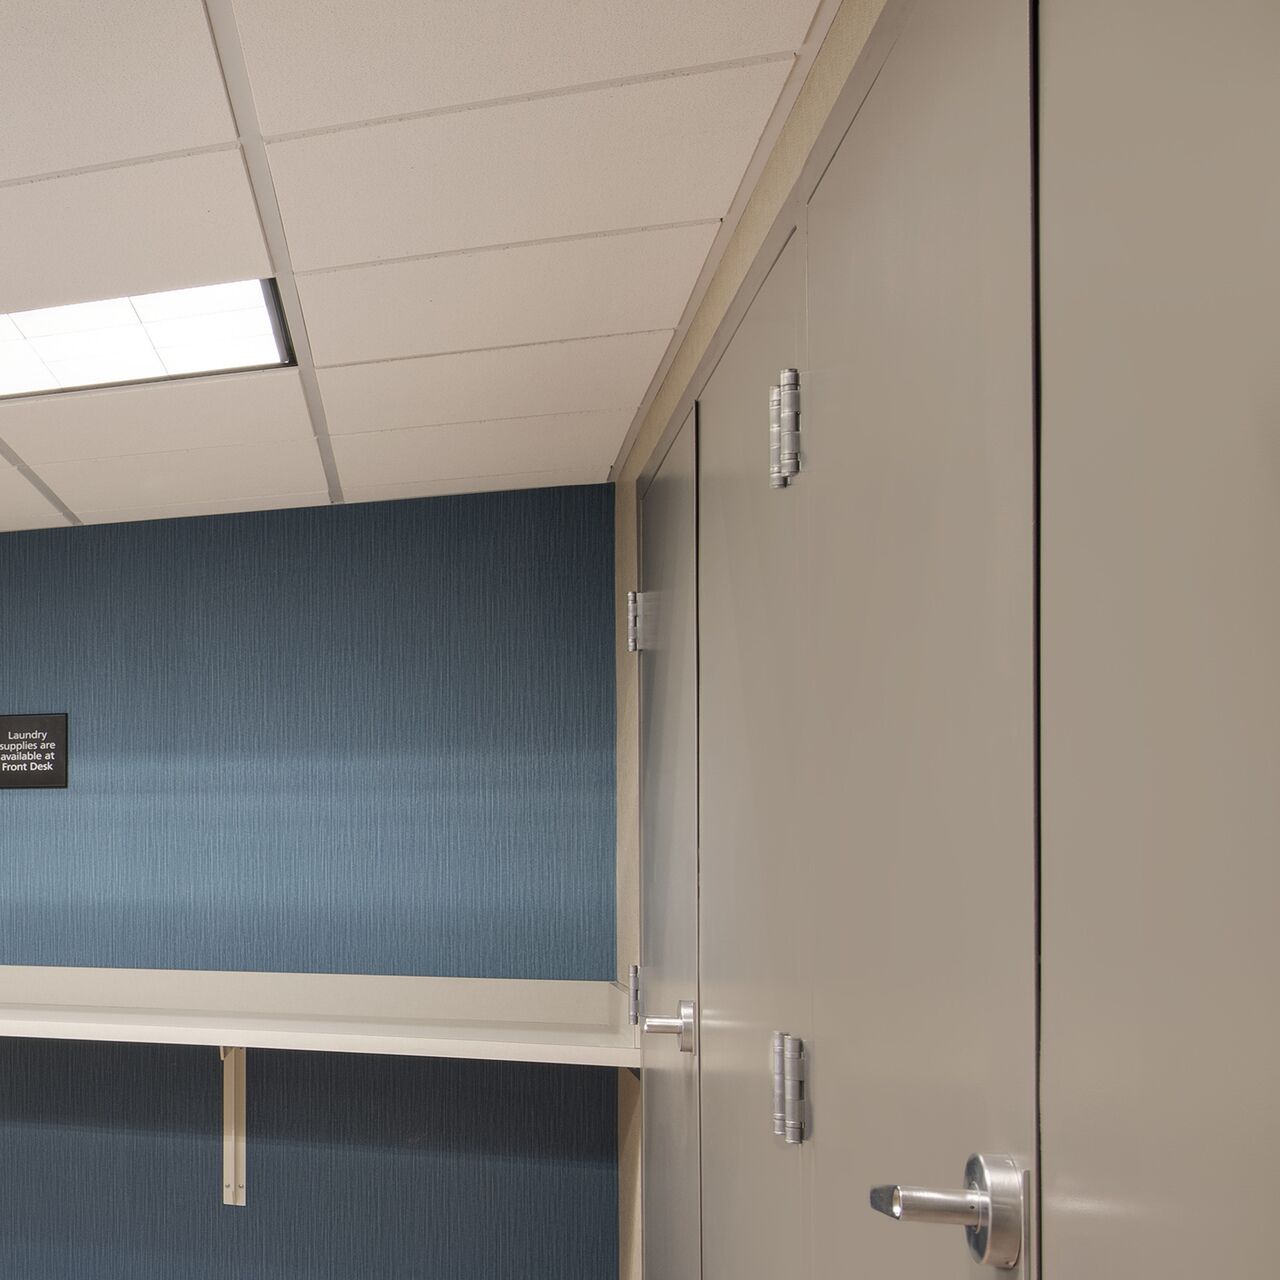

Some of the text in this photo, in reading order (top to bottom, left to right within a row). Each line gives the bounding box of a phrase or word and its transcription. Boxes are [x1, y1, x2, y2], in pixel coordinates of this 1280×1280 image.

[8, 730, 48, 741] Laundry
[0, 741, 56, 752] supplies are
[0, 751, 56, 761] available at
[2, 761, 54, 771] Front Desk
